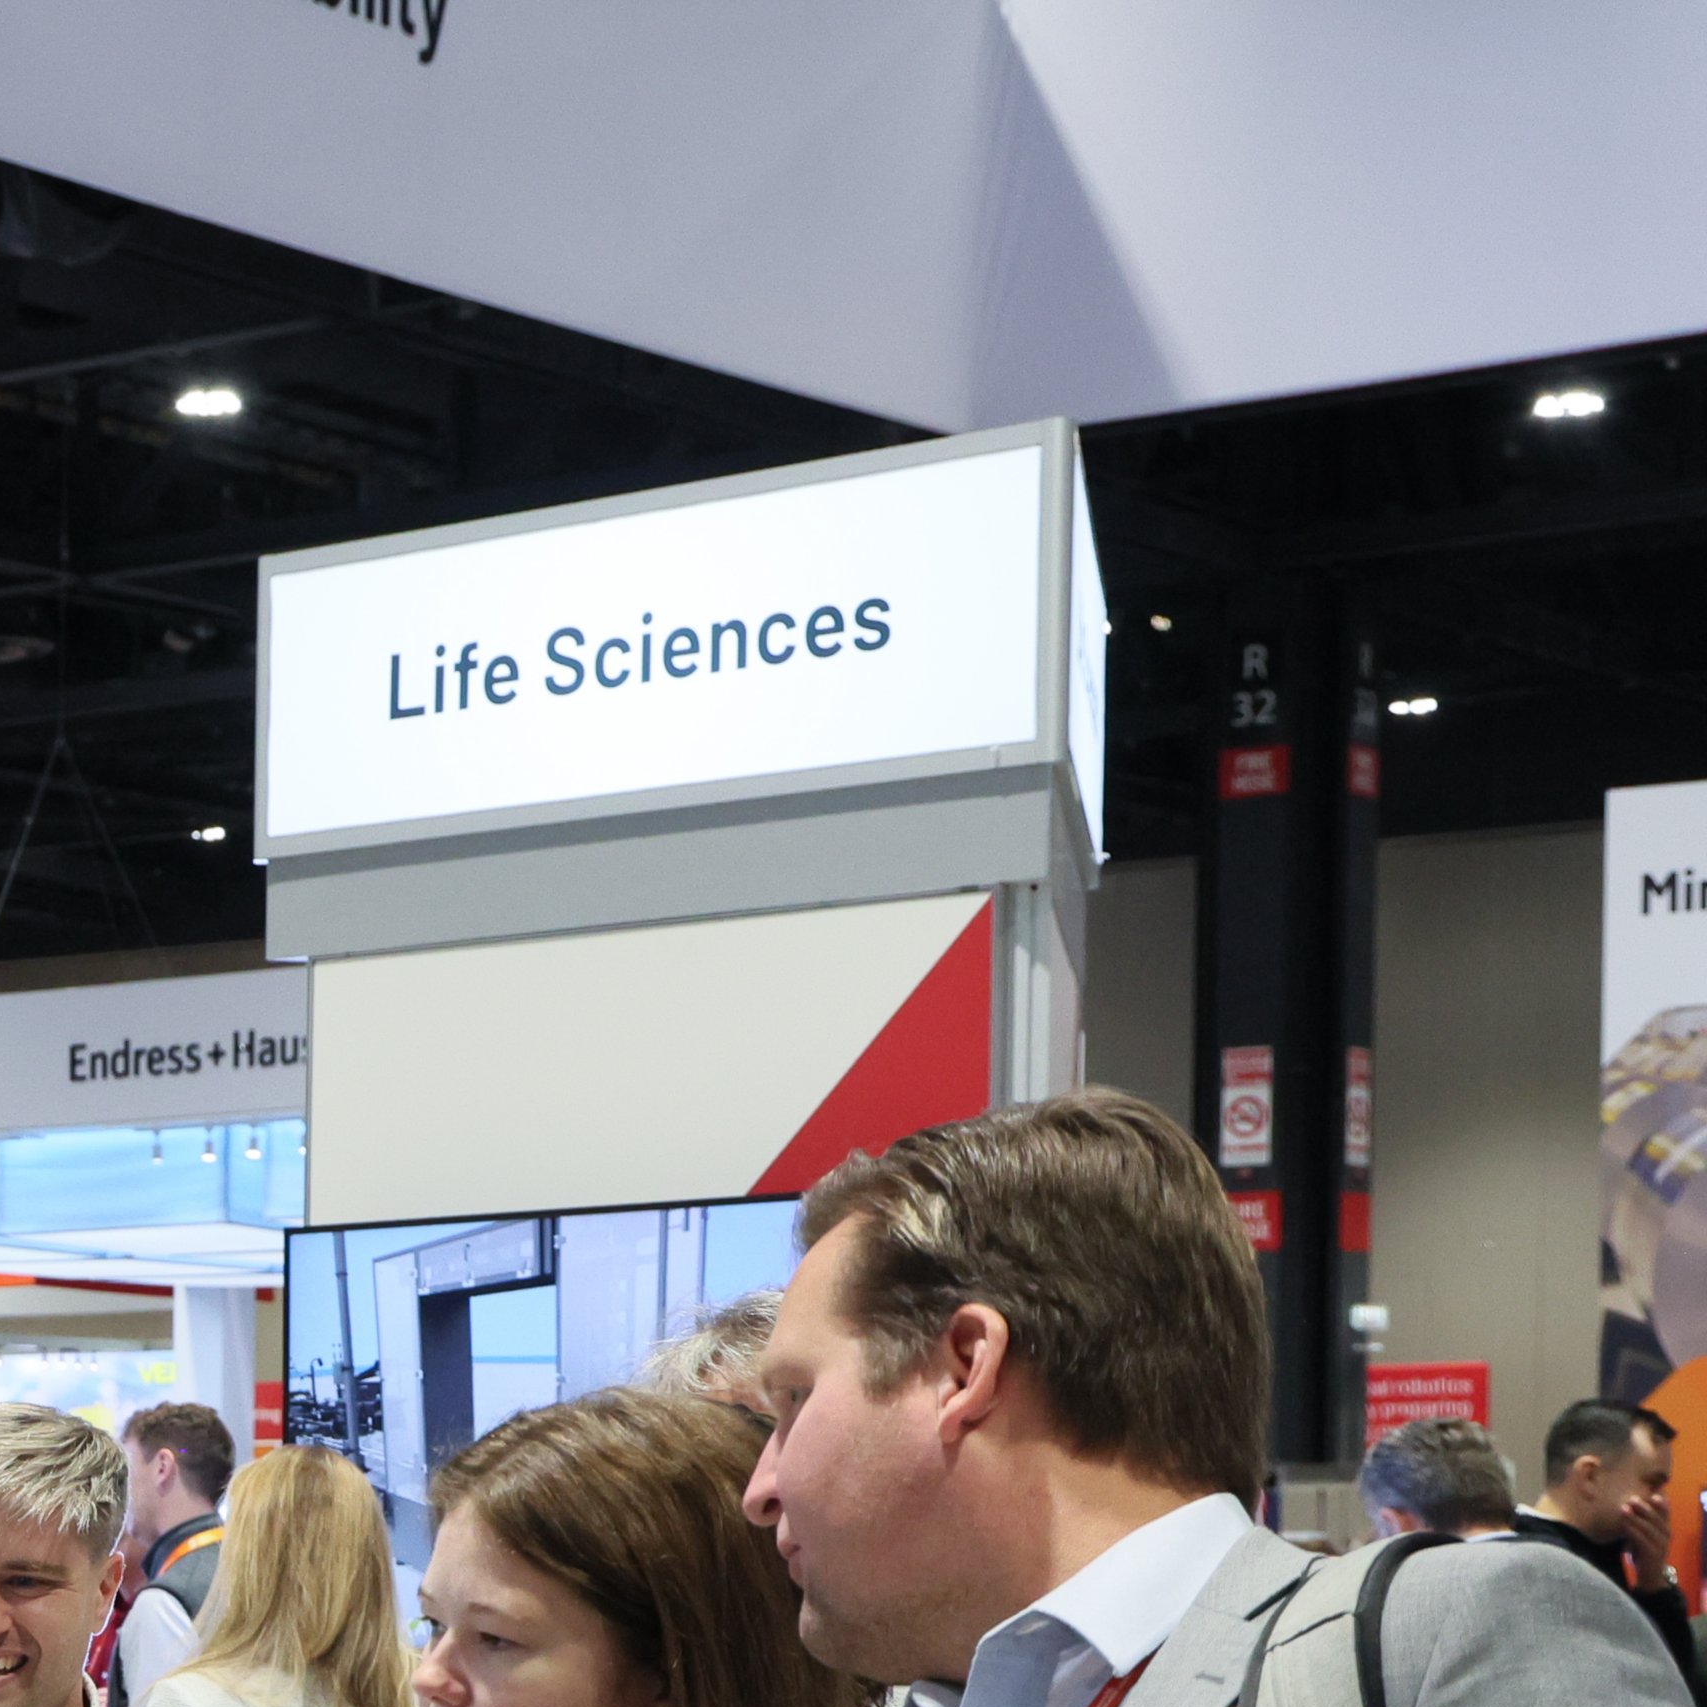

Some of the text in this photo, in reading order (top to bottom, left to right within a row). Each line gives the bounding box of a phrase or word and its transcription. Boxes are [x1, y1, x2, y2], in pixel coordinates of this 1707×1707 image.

[388, 596, 891, 720] Life Sciences
[1242, 644, 1269, 681] R
[1231, 688, 1277, 728] 32
[1640, 868, 1707, 915] Mi
